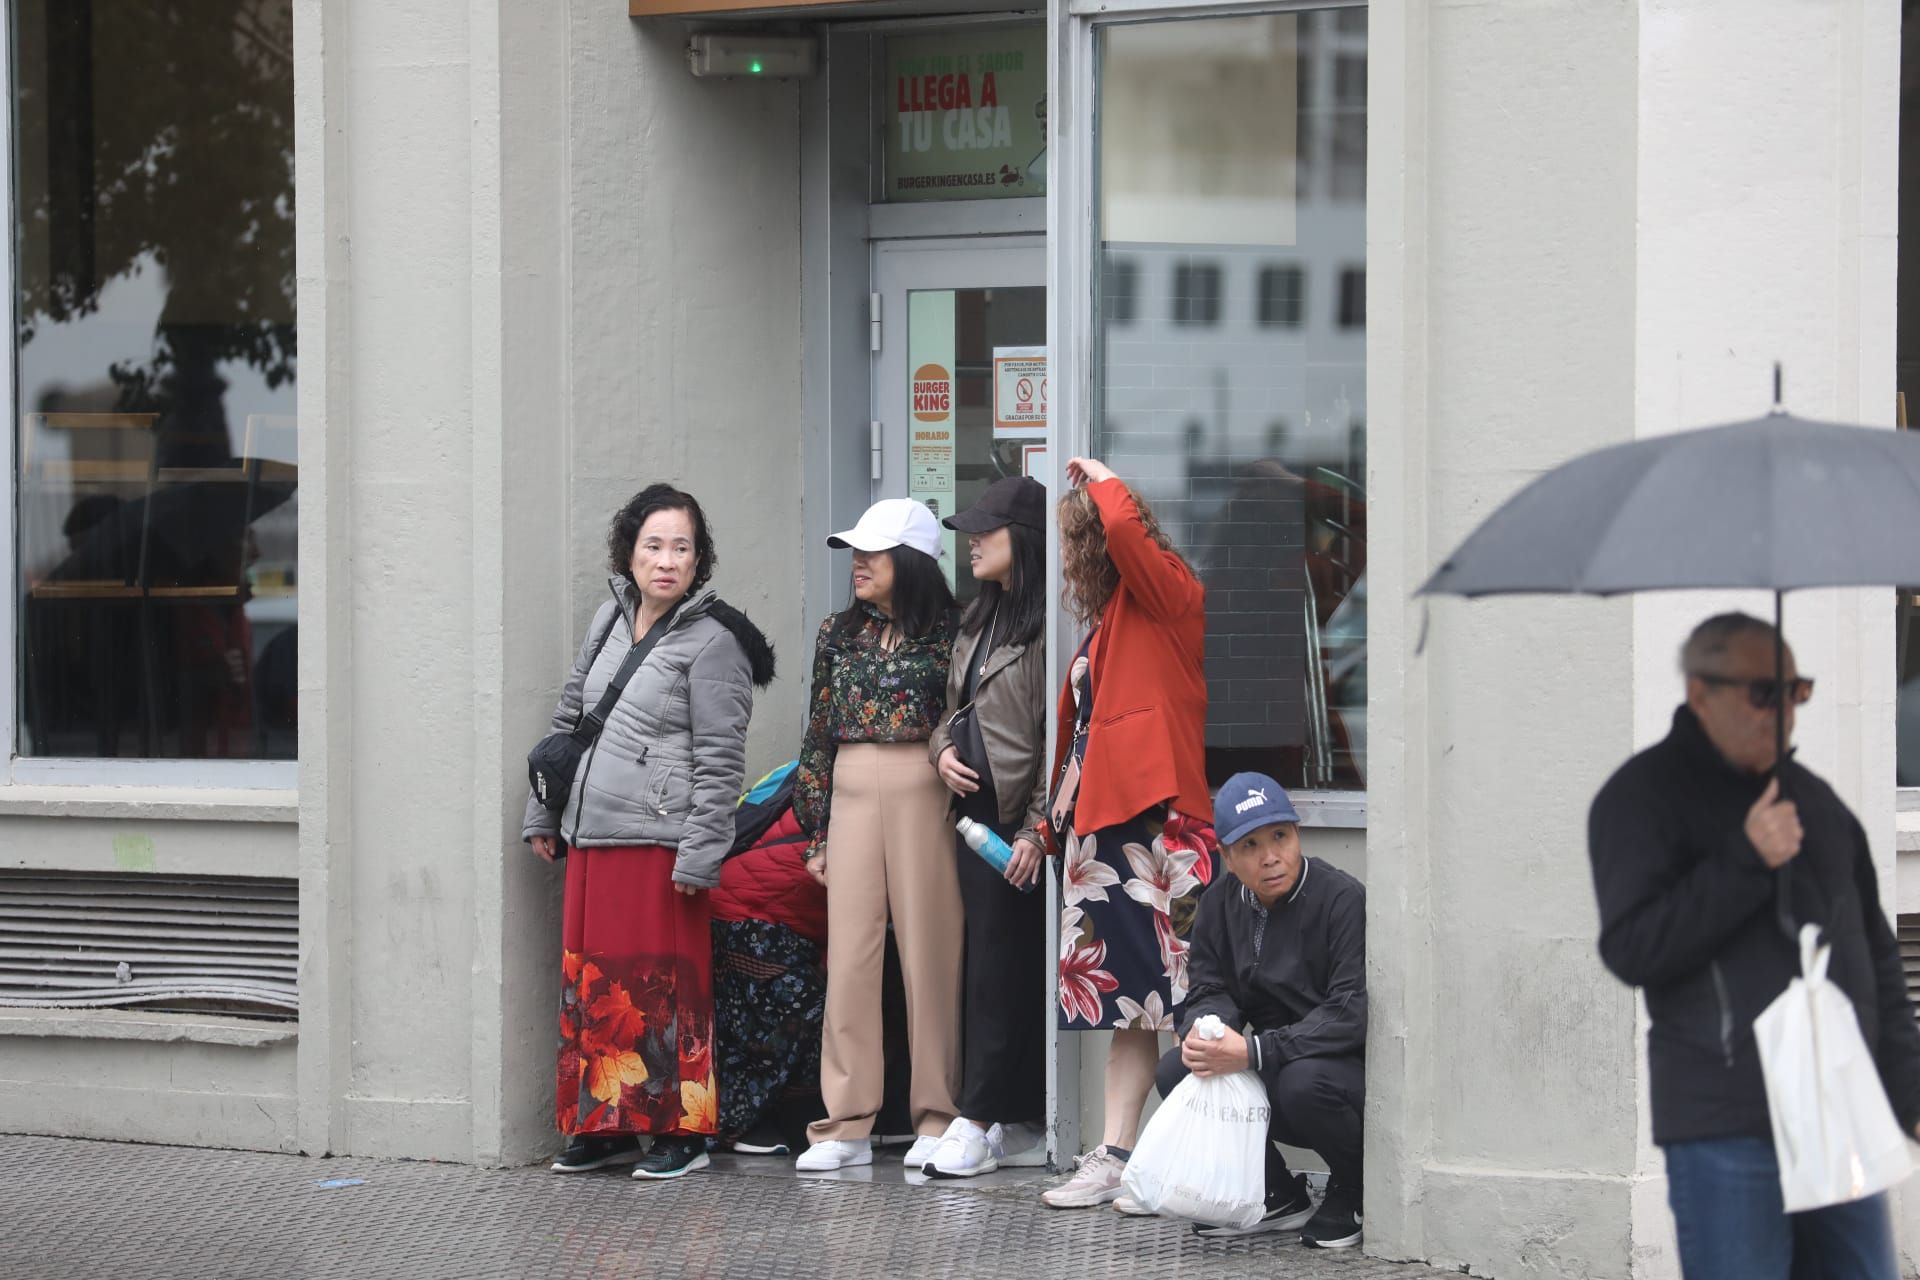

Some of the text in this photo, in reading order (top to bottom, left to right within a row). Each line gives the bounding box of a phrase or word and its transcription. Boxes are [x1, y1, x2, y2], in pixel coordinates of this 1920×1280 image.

[897, 71, 998, 112] LLEGA A
[898, 106, 1013, 153] TU CASA
[897, 172, 996, 190] BURGERKINGENCASA.ES
[913, 381, 950, 394] BURGER
[913, 393, 950, 411] KING
[915, 431, 950, 441] HORARIO
[1235, 796, 1264, 815] PUMA
